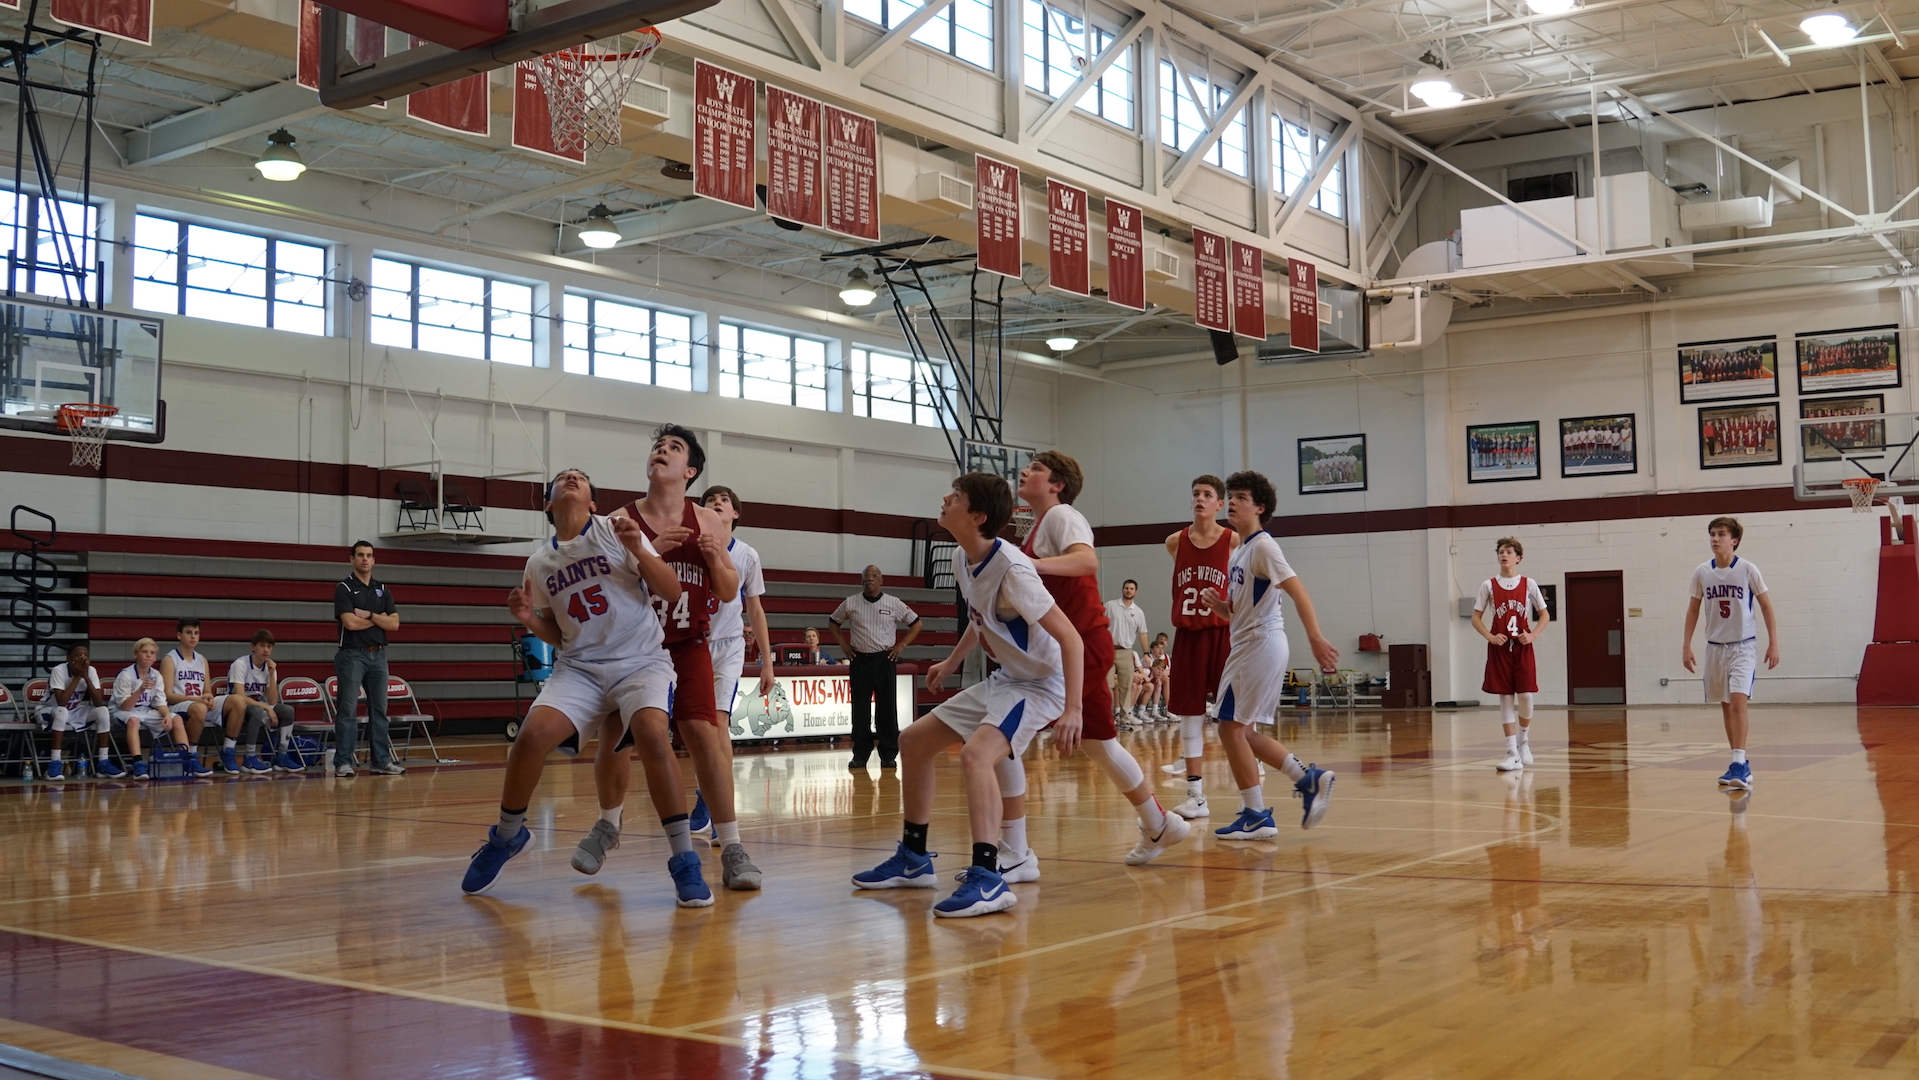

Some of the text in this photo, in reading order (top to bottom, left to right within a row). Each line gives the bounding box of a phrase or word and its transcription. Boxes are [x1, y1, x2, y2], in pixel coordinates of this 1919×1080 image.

[697, 103, 753, 129] CHAMPIONSHIPS
[706, 97, 745, 117] BOYS STATE
[697, 114, 752, 140] INDOOR TRACK
[775, 120, 814, 139] GIRLS STATE
[768, 127, 820, 150] CHAMPIONSHIPS
[833, 138, 867, 156] BOYS STATE
[768, 138, 819, 161] OUTDOOR TRACK
[826, 146, 874, 166] CHAMPIONSHIPS
[826, 155, 874, 177] OUTDOOR TRACK
[977, 201, 1017, 220] CROSS COUNTRY
[1048, 222, 1086, 240] CROSS COUNTRY
[1114, 242, 1136, 255] SOCCER
[1203, 269, 1217, 279] GOLF
[546, 555, 612, 597] SAINTS
[1177, 565, 1226, 589] UMS-WRIGHT
[1706, 584, 1744, 600] SAINTS
[567, 583, 609, 624] 45
[1718, 600, 1731, 619] 5
[1506, 615, 1519, 637] 4
[178, 670, 205, 682] SAINTS
[184, 682, 202, 697] 25
[285, 686, 317, 696] BULLDOGS
[803, 712, 827, 728] Home
[828, 711, 837, 726] of
[838, 710, 849, 726] the
